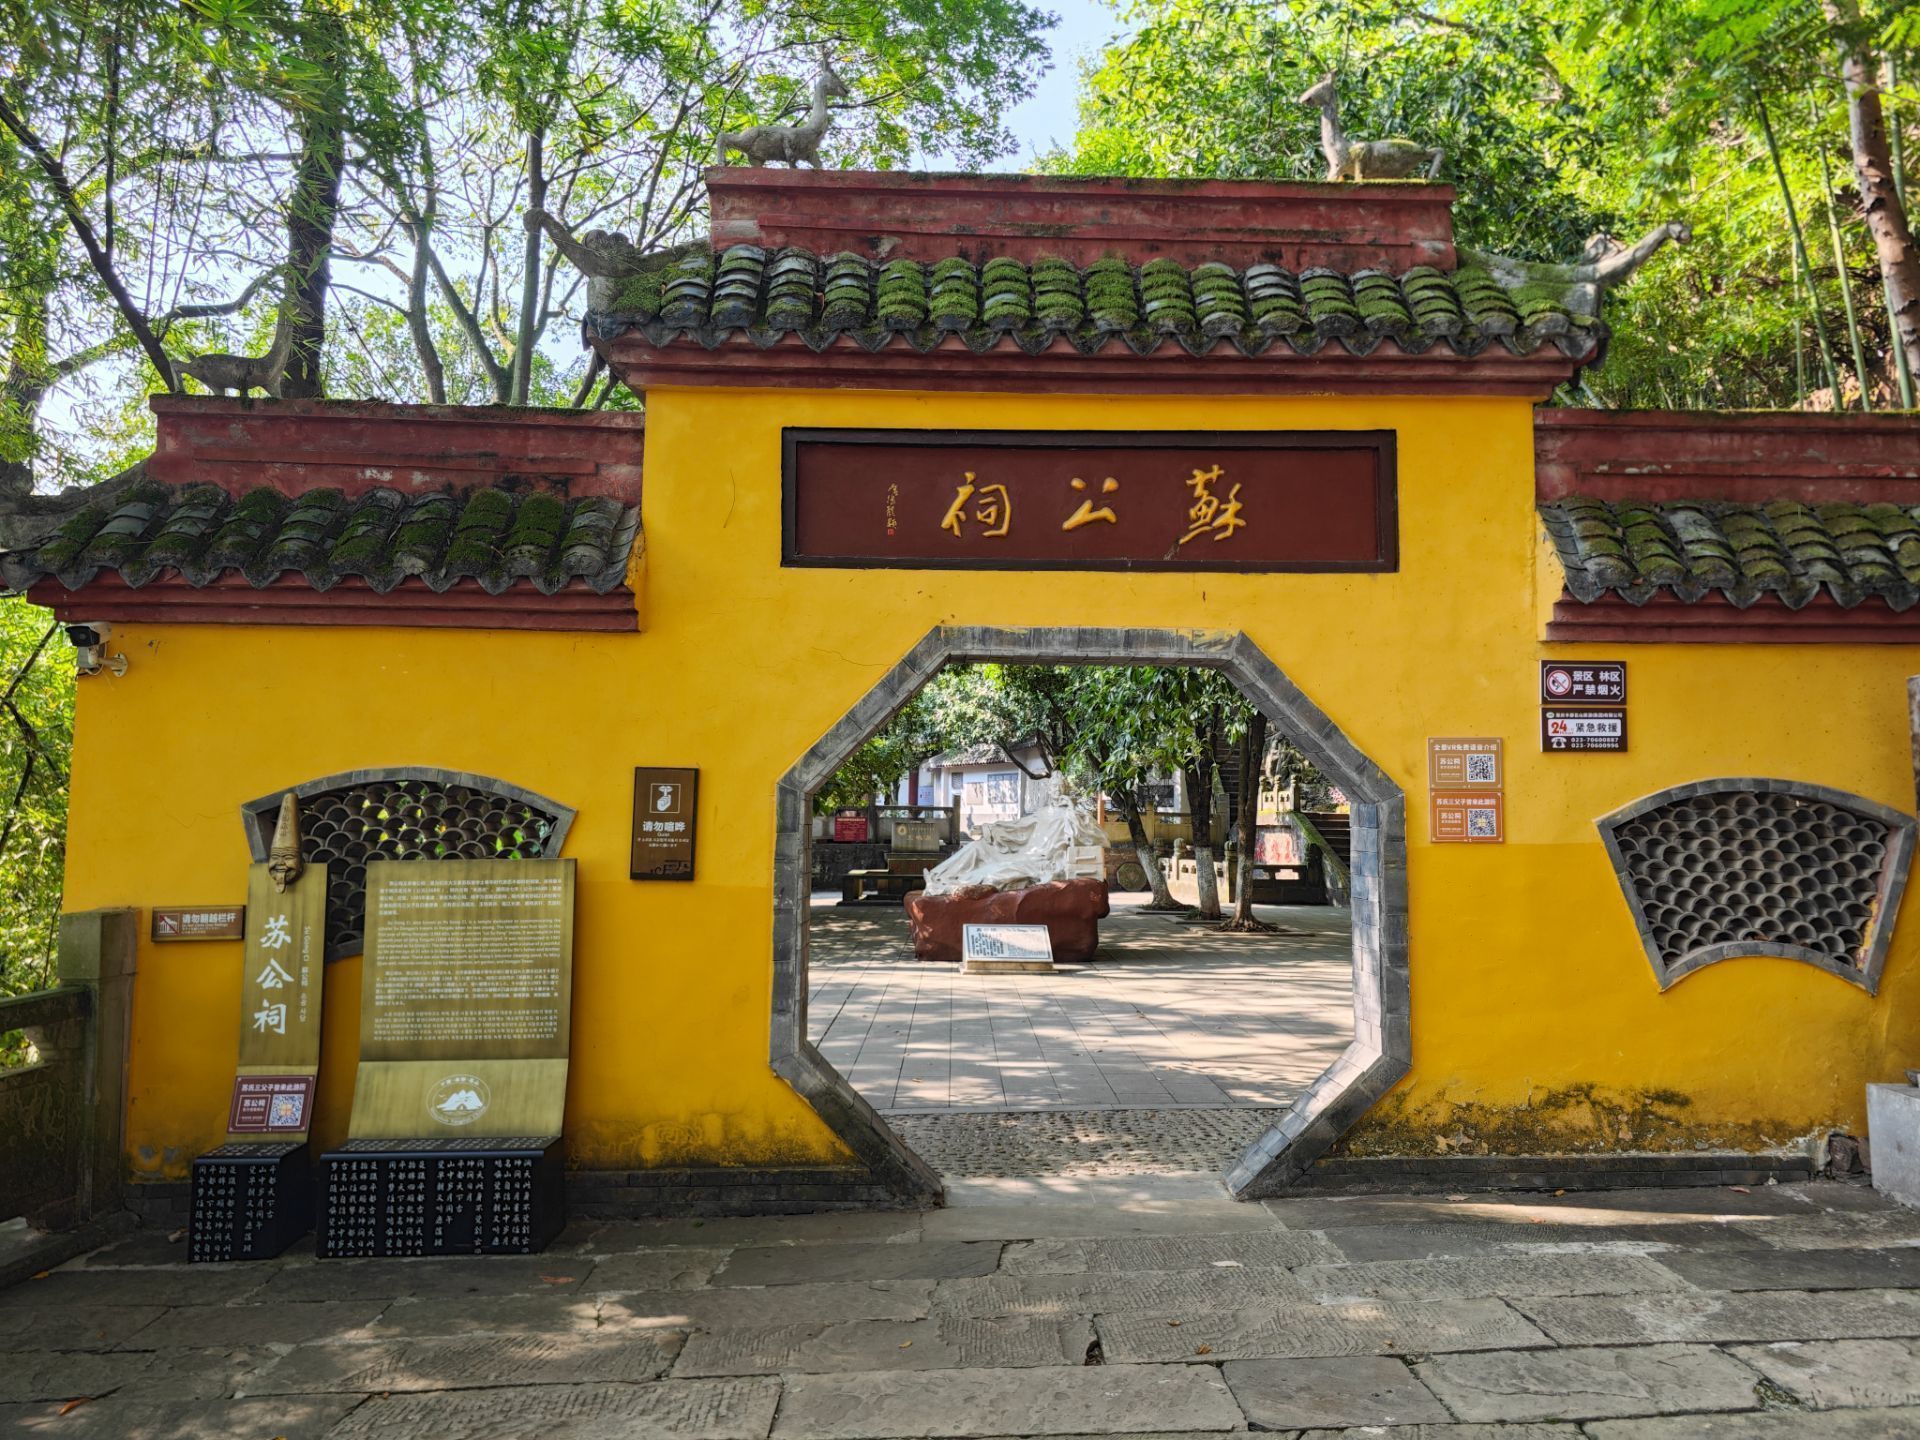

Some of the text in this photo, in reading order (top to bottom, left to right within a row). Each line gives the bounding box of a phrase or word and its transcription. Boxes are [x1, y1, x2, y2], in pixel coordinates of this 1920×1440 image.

[941, 465, 1247, 544] 蘇公祠
[1572, 671, 1620, 682] 景区 林区
[1572, 684, 1620, 696] 严禁烟火
[1551, 720, 1567, 734] 24
[1576, 722, 1617, 733] 紧急救援
[642, 821, 686, 832] 请勿喧哗
[182, 912, 237, 923] 请勿翻越栏杆
[252, 914, 295, 1035] 苏公祠
[244, 1099, 266, 1107] 苏公祠
